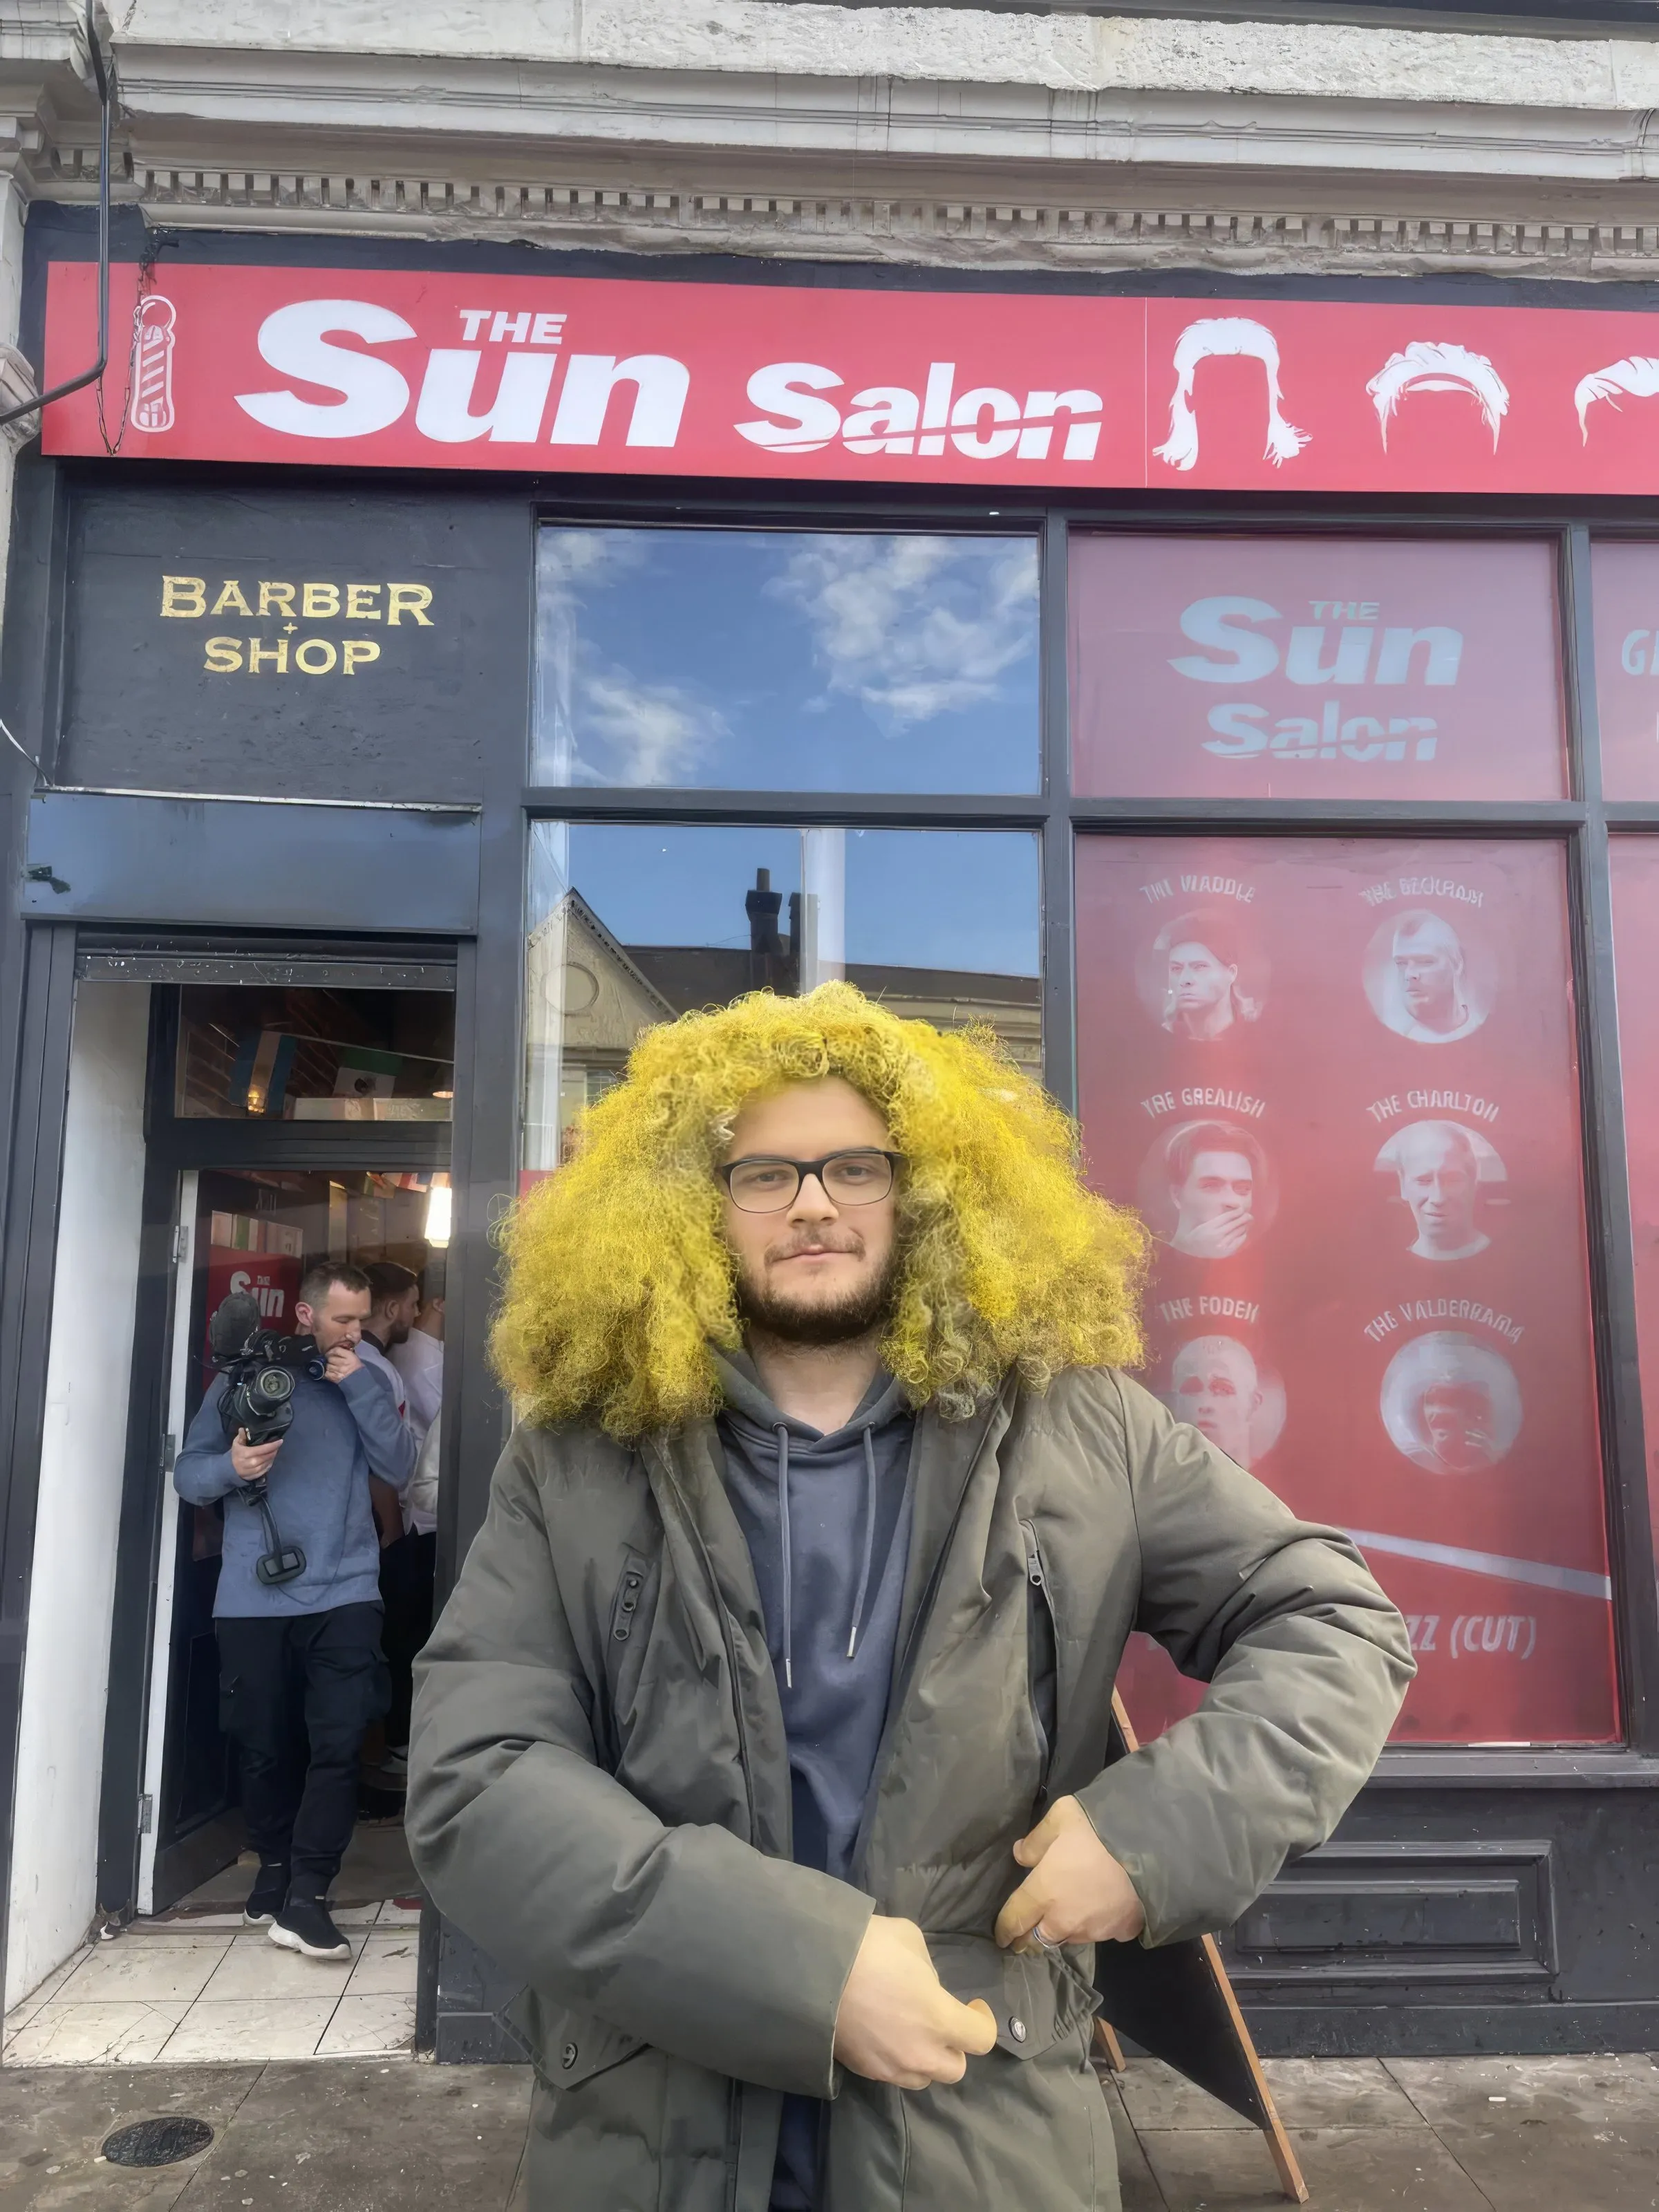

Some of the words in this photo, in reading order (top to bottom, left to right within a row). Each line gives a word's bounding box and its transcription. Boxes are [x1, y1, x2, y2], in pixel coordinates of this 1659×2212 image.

[459, 309, 567, 345] THE
[234, 299, 691, 447] Sun
[733, 362, 1104, 460] Salon
[160, 575, 434, 626] BARBER
[1309, 601, 1380, 620] THE
[204, 637, 381, 675] SHOP
[1166, 595, 1463, 686] Sun
[1201, 700, 1438, 762] Salon
[1366, 1095, 1402, 1123] THE
[1407, 1089, 1499, 1123] CHARLTON
[1159, 1297, 1193, 1324] THE
[1199, 1295, 1259, 1324] FODEN
[1364, 1311, 1398, 1342] THE
[1450, 1615, 1537, 1660] (CUT)
